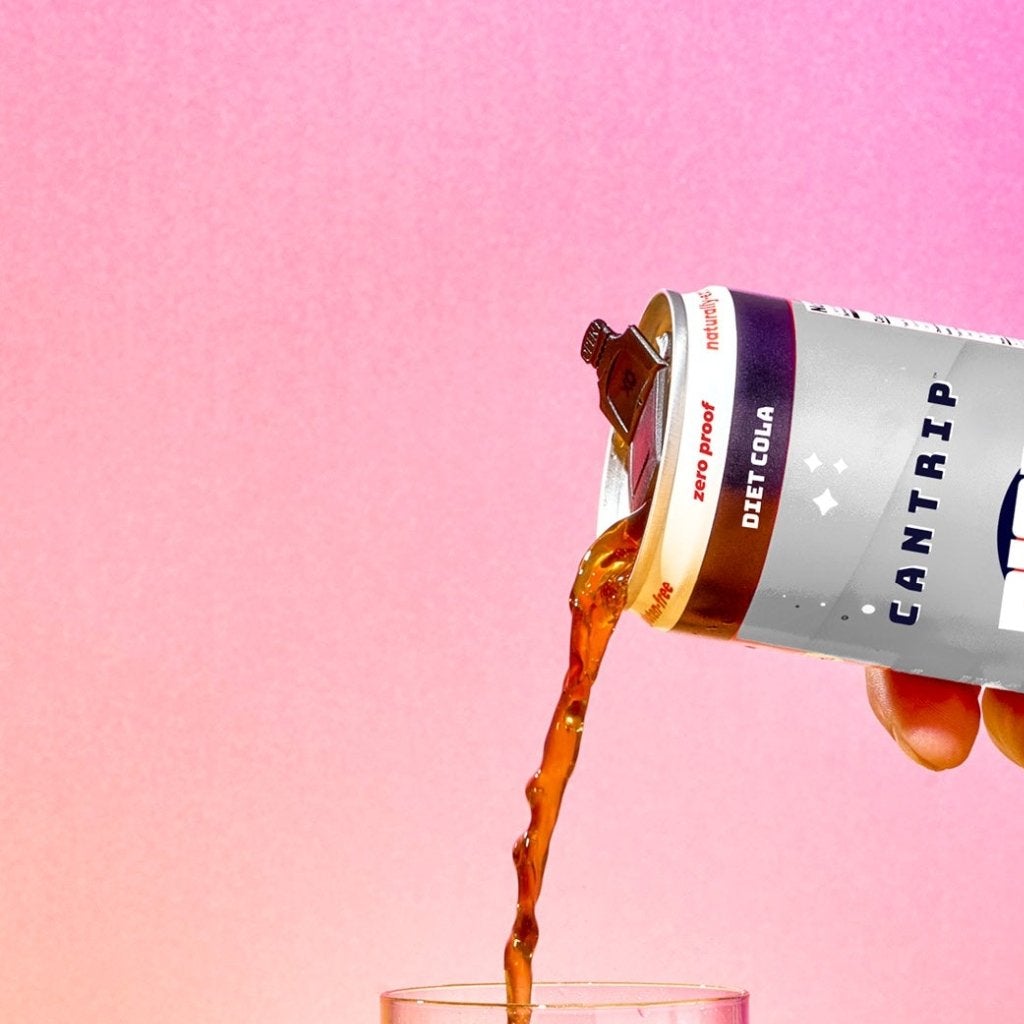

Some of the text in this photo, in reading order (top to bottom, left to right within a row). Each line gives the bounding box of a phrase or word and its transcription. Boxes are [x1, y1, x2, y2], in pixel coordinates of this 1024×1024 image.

[693, 400, 716, 502] zero proof
[741, 405, 775, 529] DIET COLA
[889, 380, 958, 626] CANTRIP
